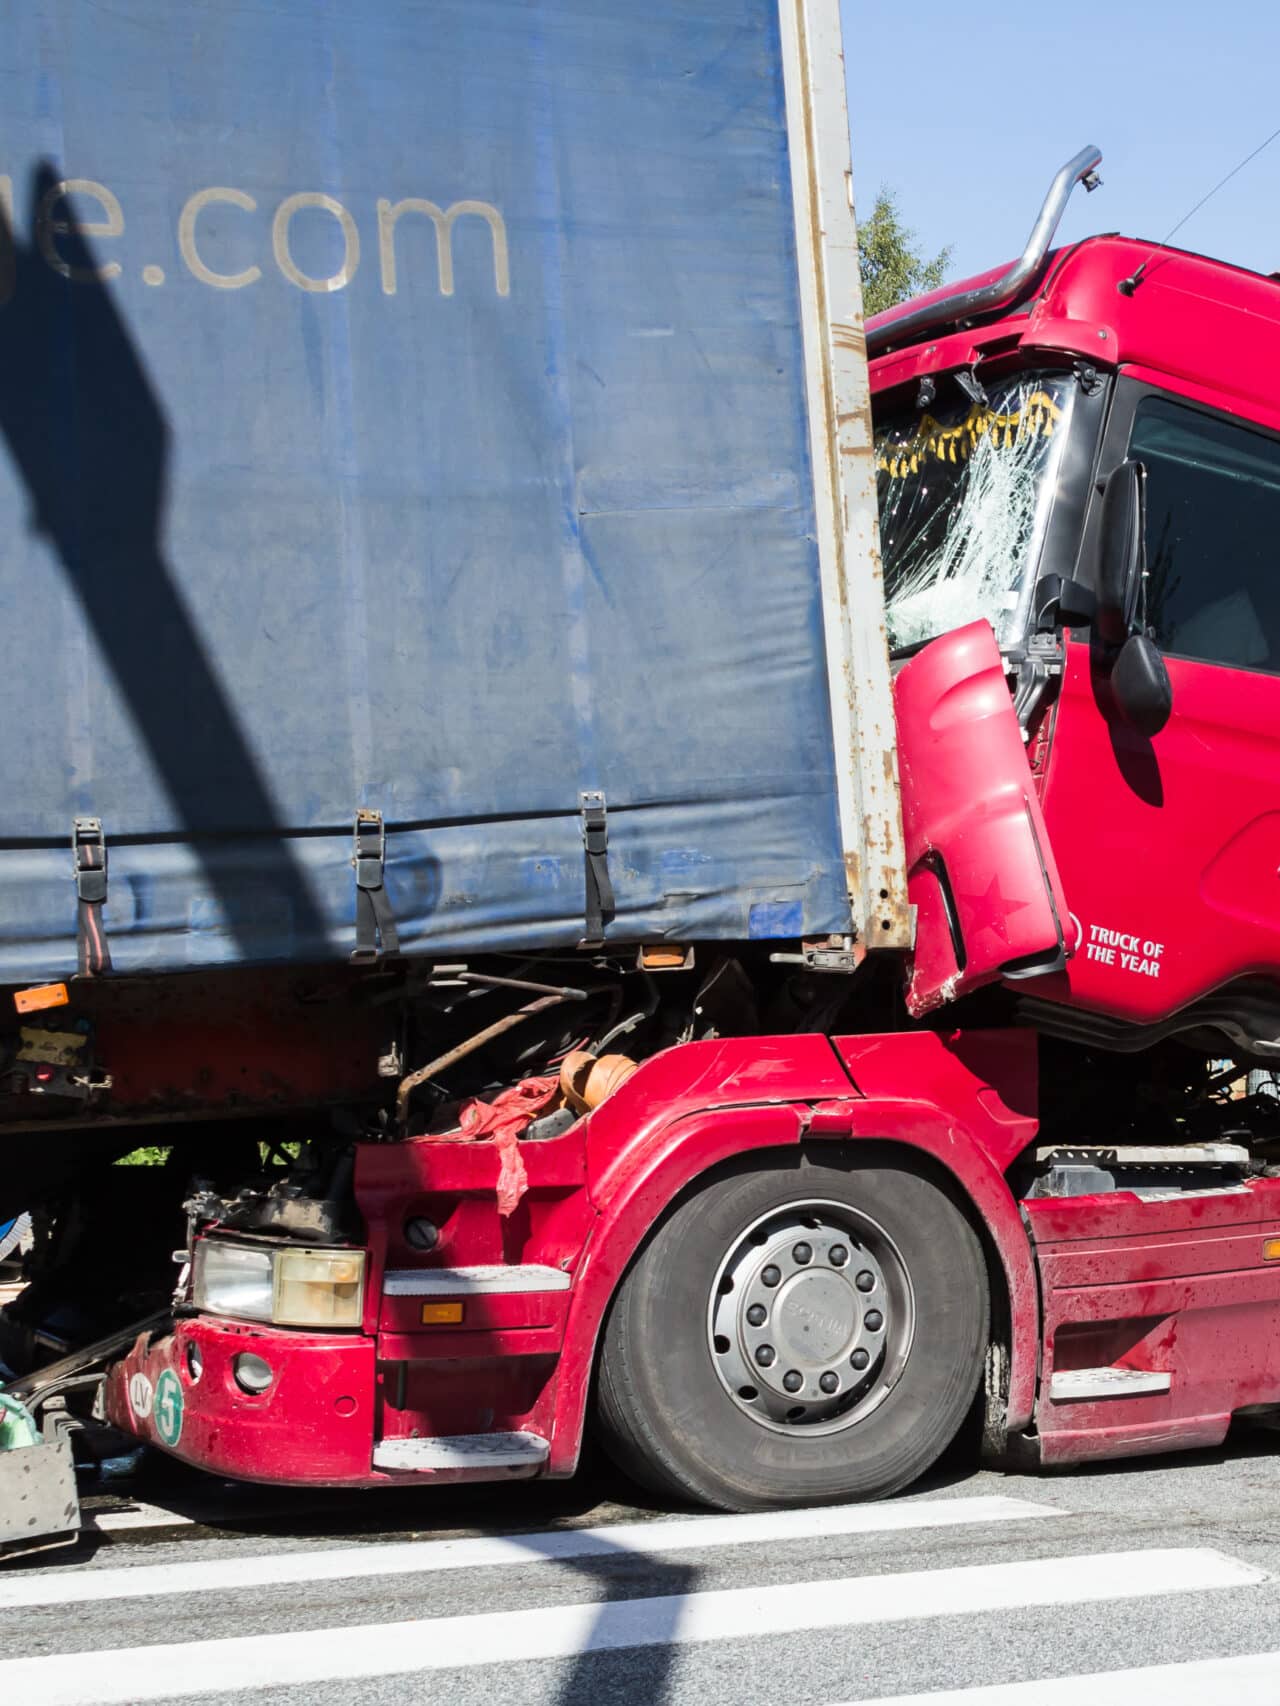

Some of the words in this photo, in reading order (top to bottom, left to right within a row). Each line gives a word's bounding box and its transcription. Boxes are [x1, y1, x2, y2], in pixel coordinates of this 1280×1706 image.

[0, 174, 510, 296] e.com
[1087, 944, 1116, 965] THE
[1120, 953, 1160, 977] YEAR
[1090, 925, 1140, 952] TRUCK
[1143, 941, 1164, 958] OF
[161, 1378, 177, 1436] 5
